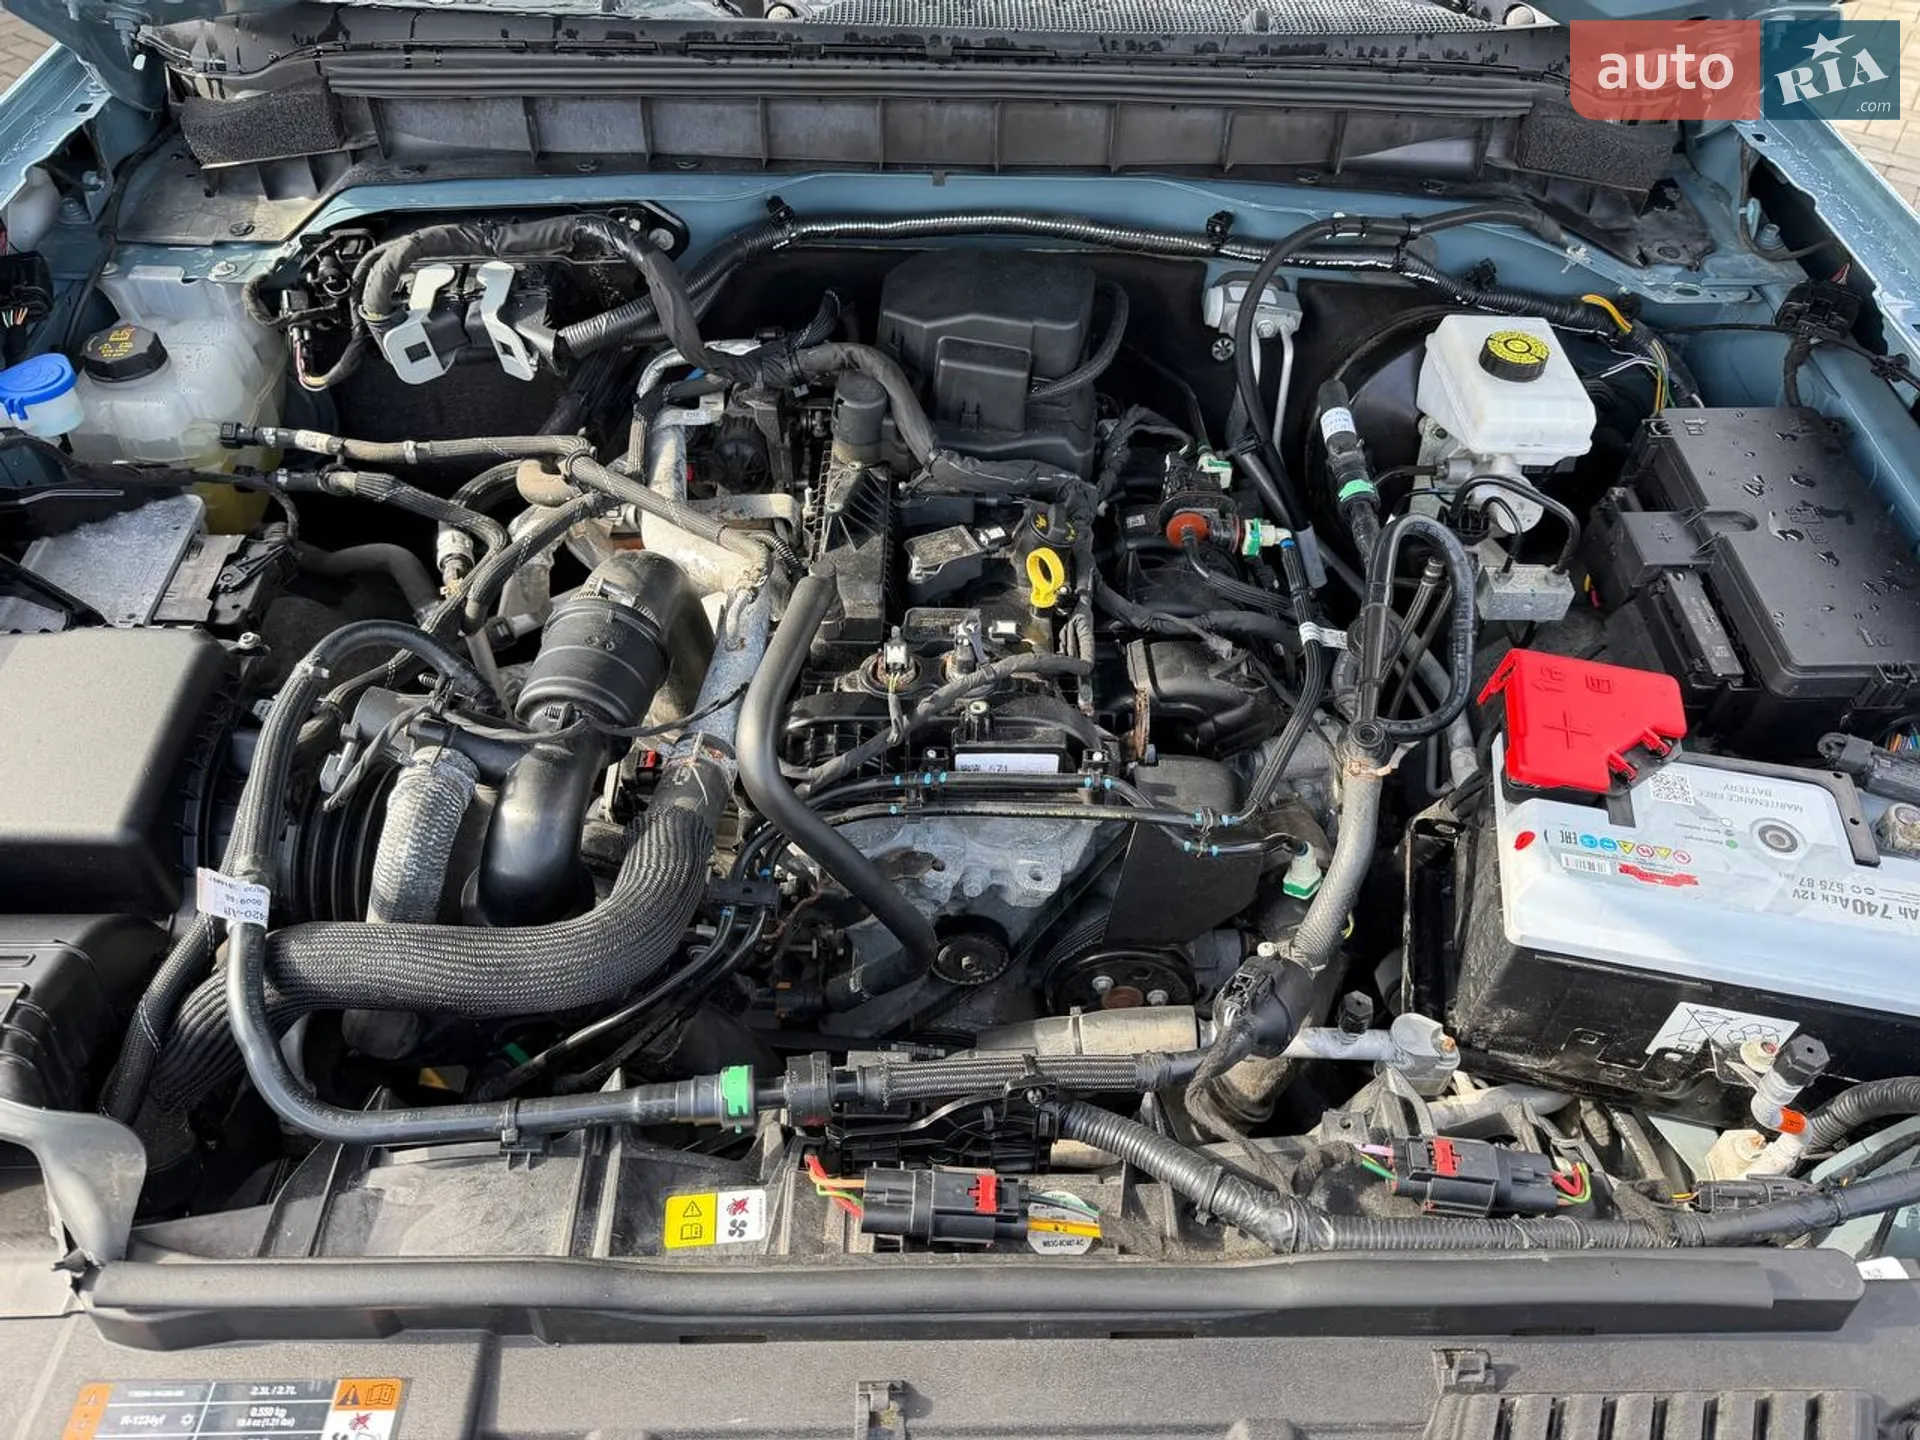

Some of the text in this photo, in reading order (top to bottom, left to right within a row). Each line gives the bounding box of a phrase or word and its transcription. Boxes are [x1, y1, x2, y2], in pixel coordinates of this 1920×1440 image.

[1723, 783, 1772, 798] BATTERY
[1728, 794, 1803, 813] MAINTENANCE
[1792, 888, 1817, 901] 12V
[1852, 898, 1893, 920] 740
[1898, 906, 1919, 921] Ah
